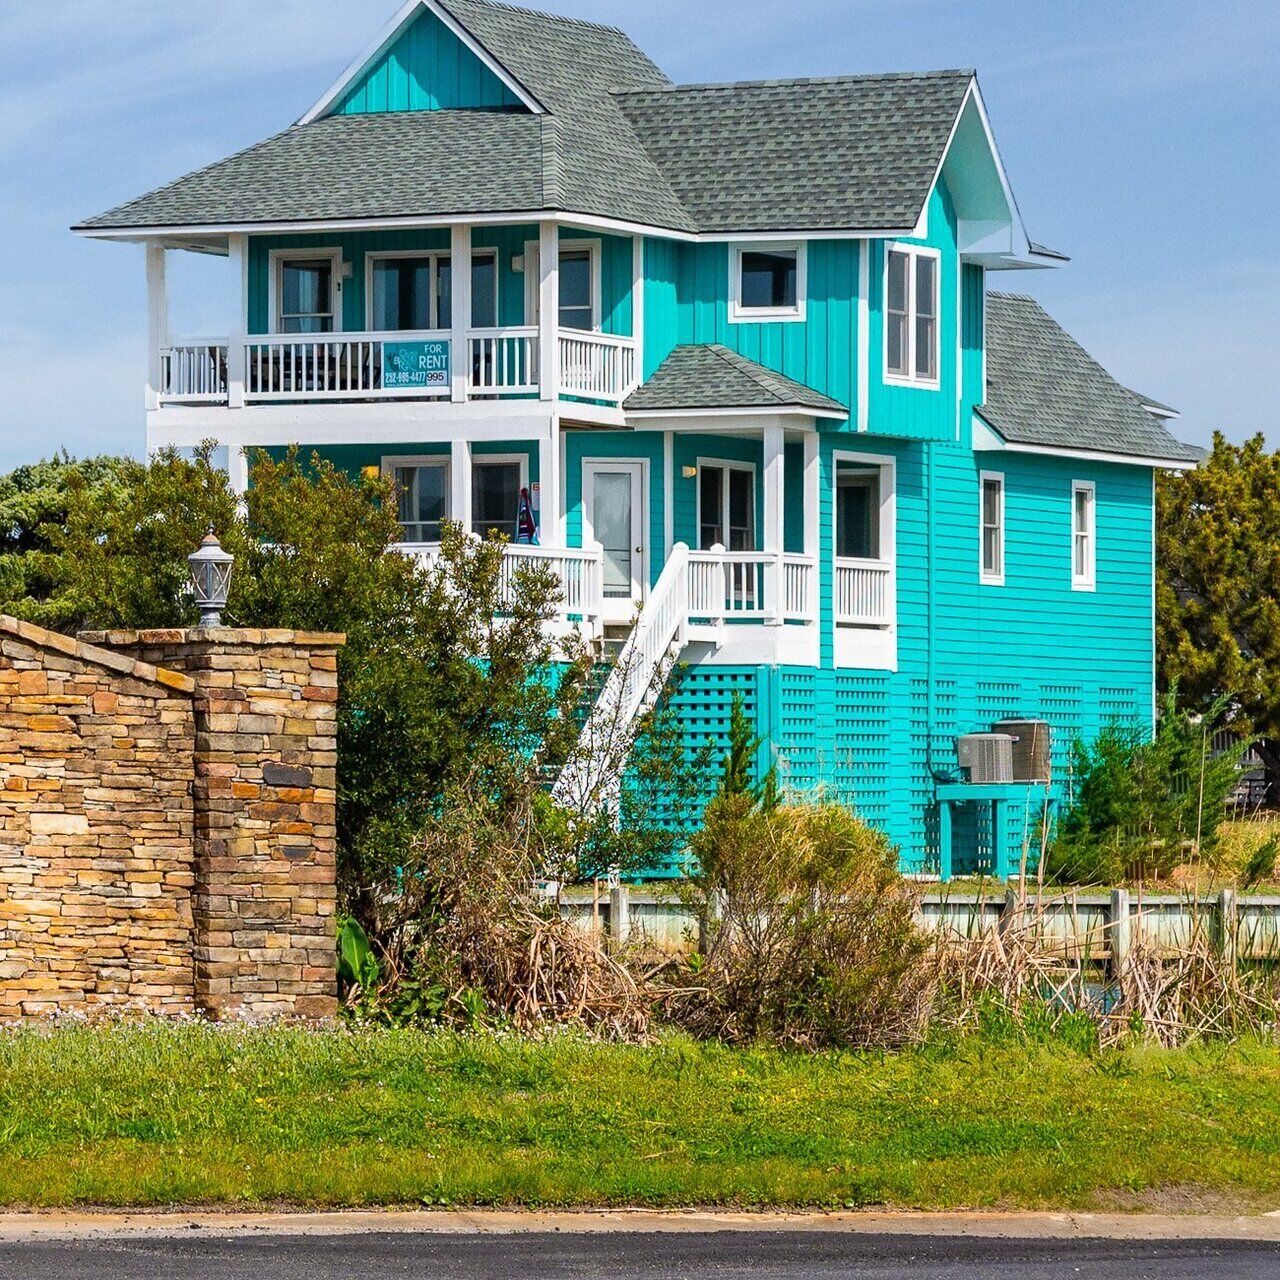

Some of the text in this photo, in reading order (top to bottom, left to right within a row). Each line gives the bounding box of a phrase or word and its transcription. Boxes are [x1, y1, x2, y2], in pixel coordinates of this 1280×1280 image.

[424, 344, 442, 353] FOR
[418, 355, 447, 369] RENT
[426, 372, 444, 381] 995
